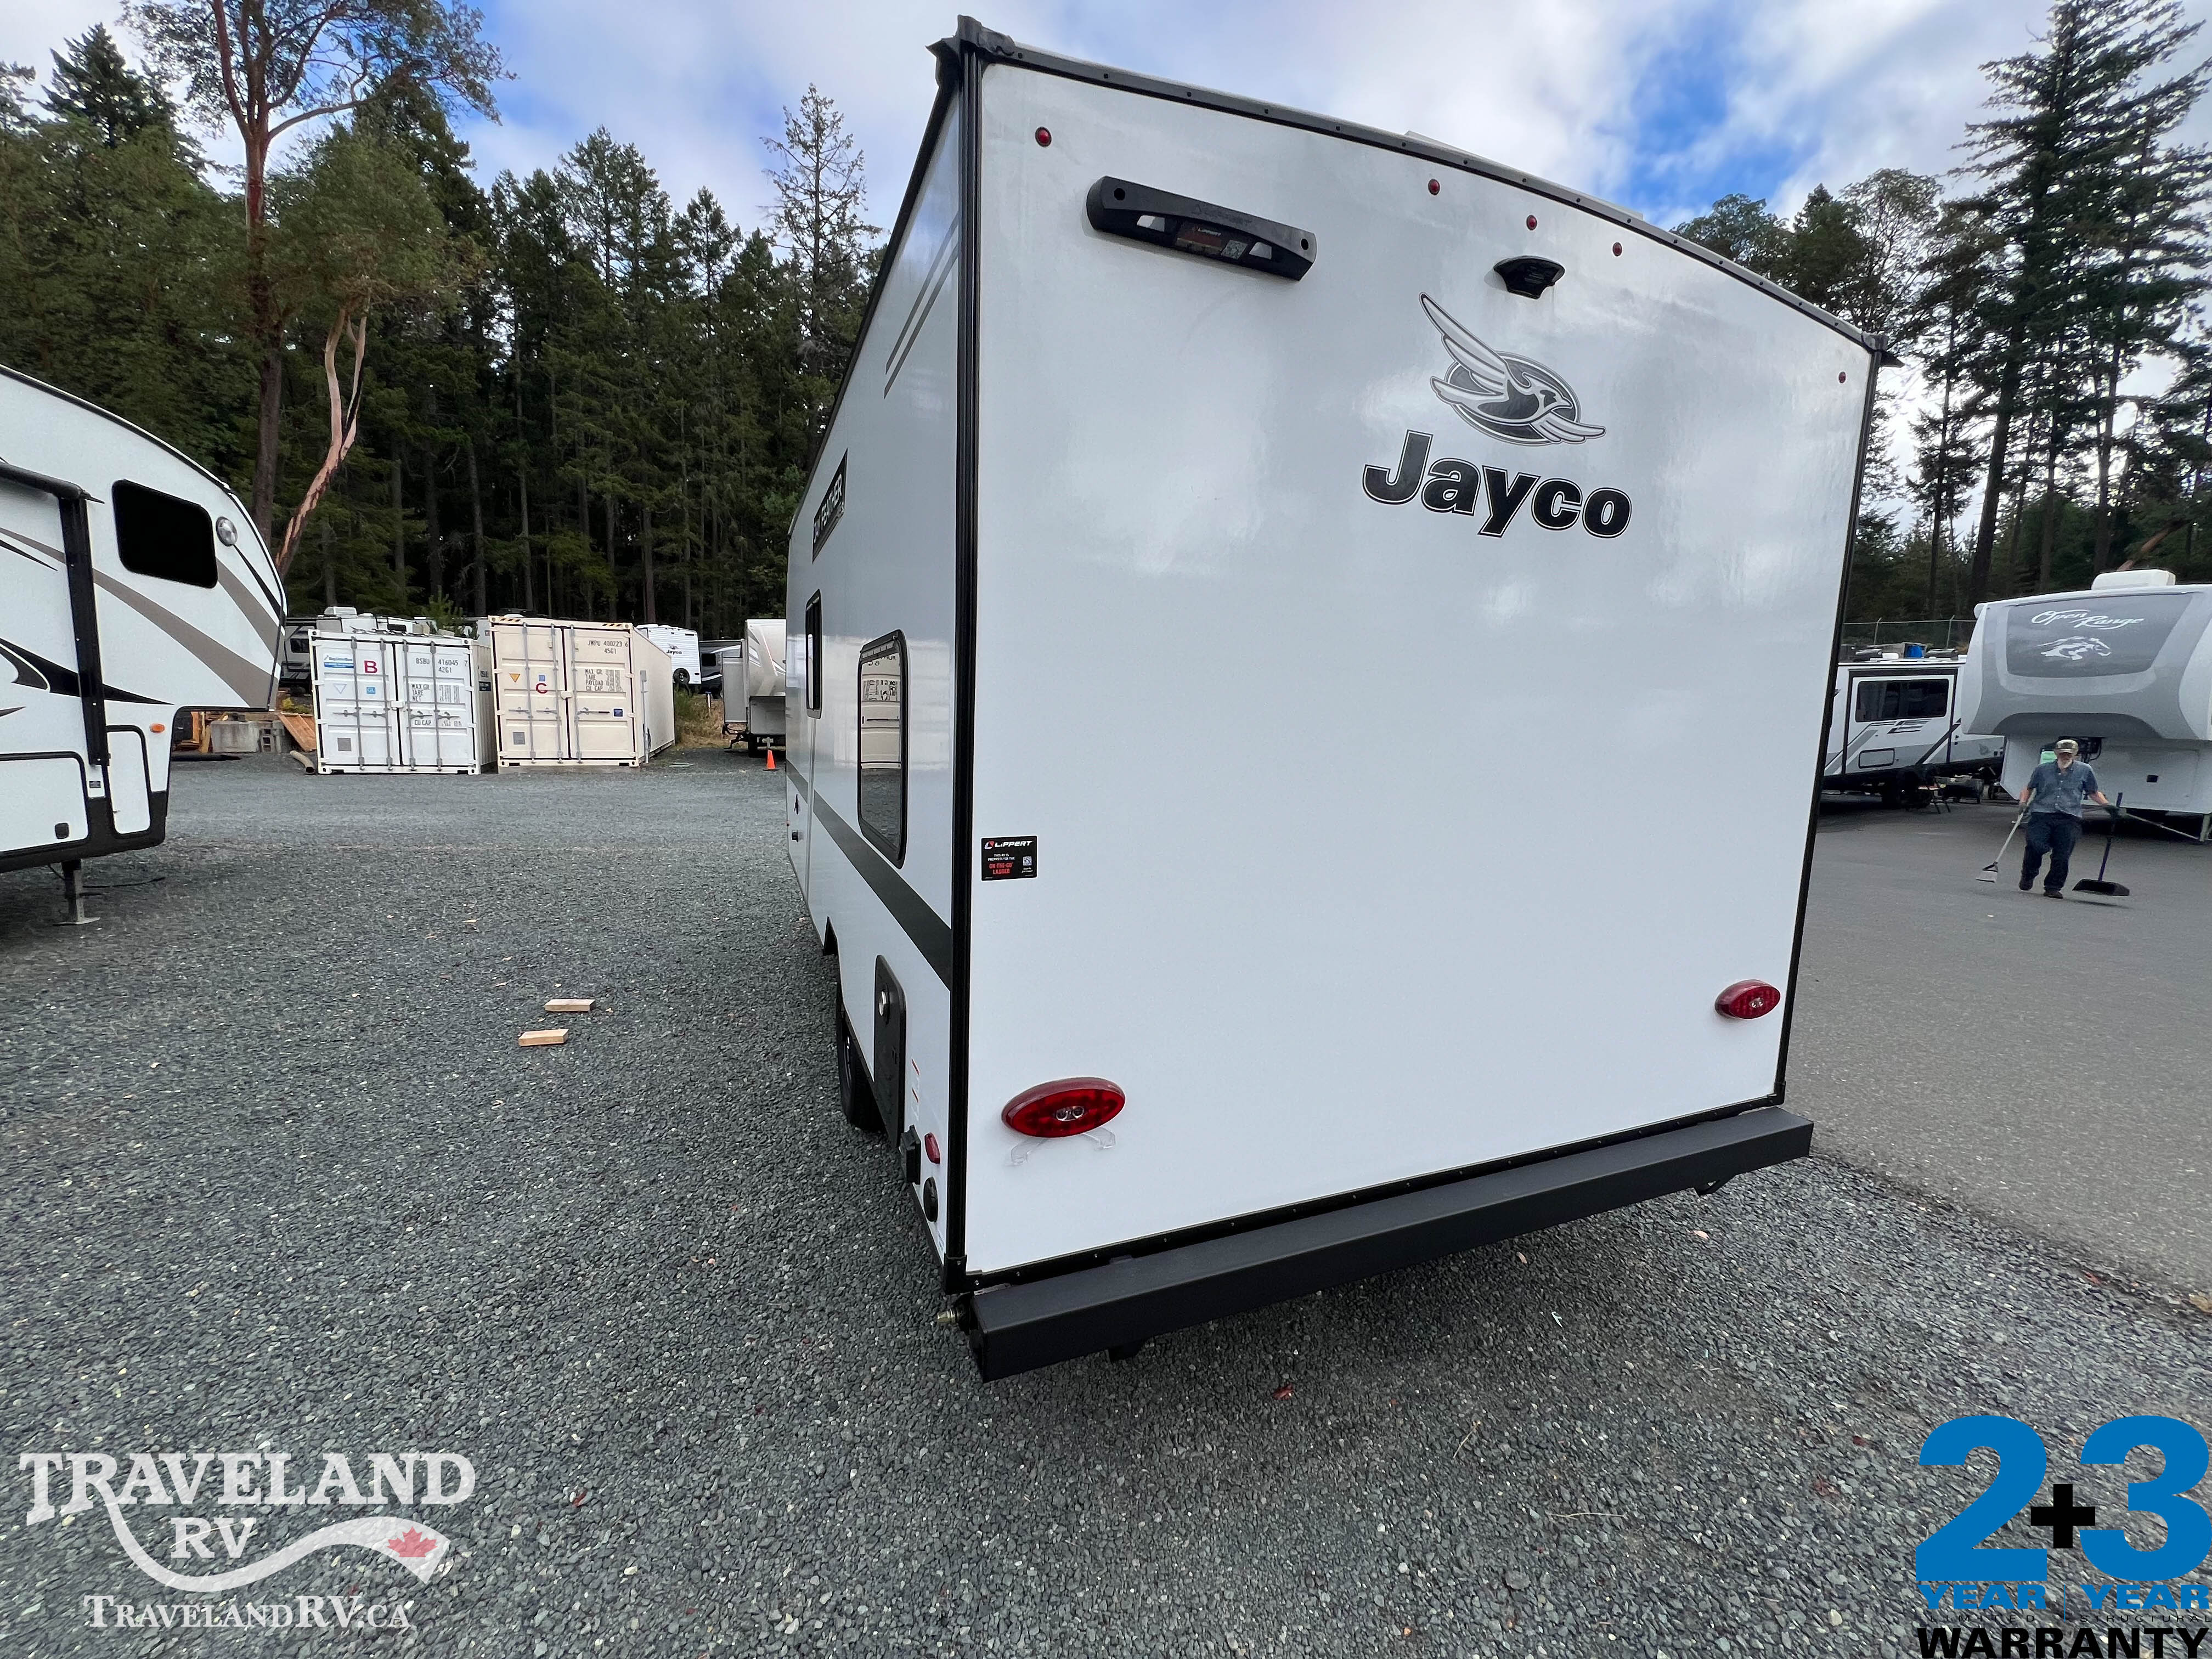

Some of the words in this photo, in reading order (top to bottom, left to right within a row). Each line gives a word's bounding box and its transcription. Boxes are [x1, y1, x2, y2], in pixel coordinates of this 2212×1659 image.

[1363, 429, 1632, 539] Jayco
[2032, 609, 2091, 625] Open
[2069, 616, 2144, 630] Range
[364, 661, 377, 673] B
[536, 683, 548, 693] C
